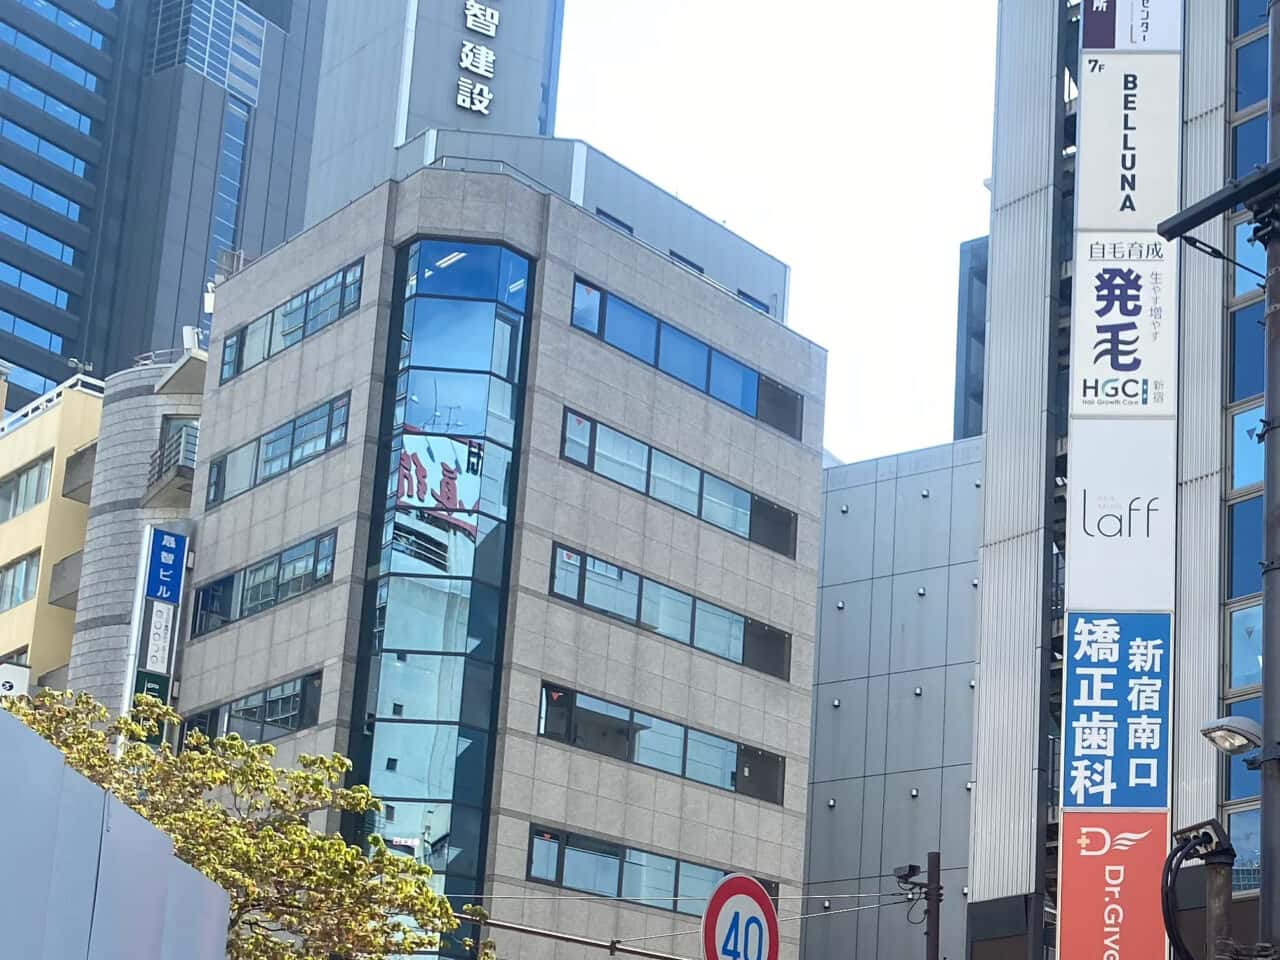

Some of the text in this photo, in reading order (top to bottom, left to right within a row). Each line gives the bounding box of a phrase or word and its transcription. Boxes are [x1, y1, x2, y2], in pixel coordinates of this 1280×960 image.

[456, 0, 499, 115] 智建設
[1088, 59, 1105, 73] 7F
[1119, 74, 1138, 212] BELLUNA
[1089, 241, 1164, 259] 自毛育成
[1094, 268, 1142, 372] 発毛
[1082, 378, 1139, 398] HGC
[1083, 489, 1159, 537] laff
[1070, 617, 1120, 805] 矯正歯科
[1127, 637, 1163, 788] 新宿南口
